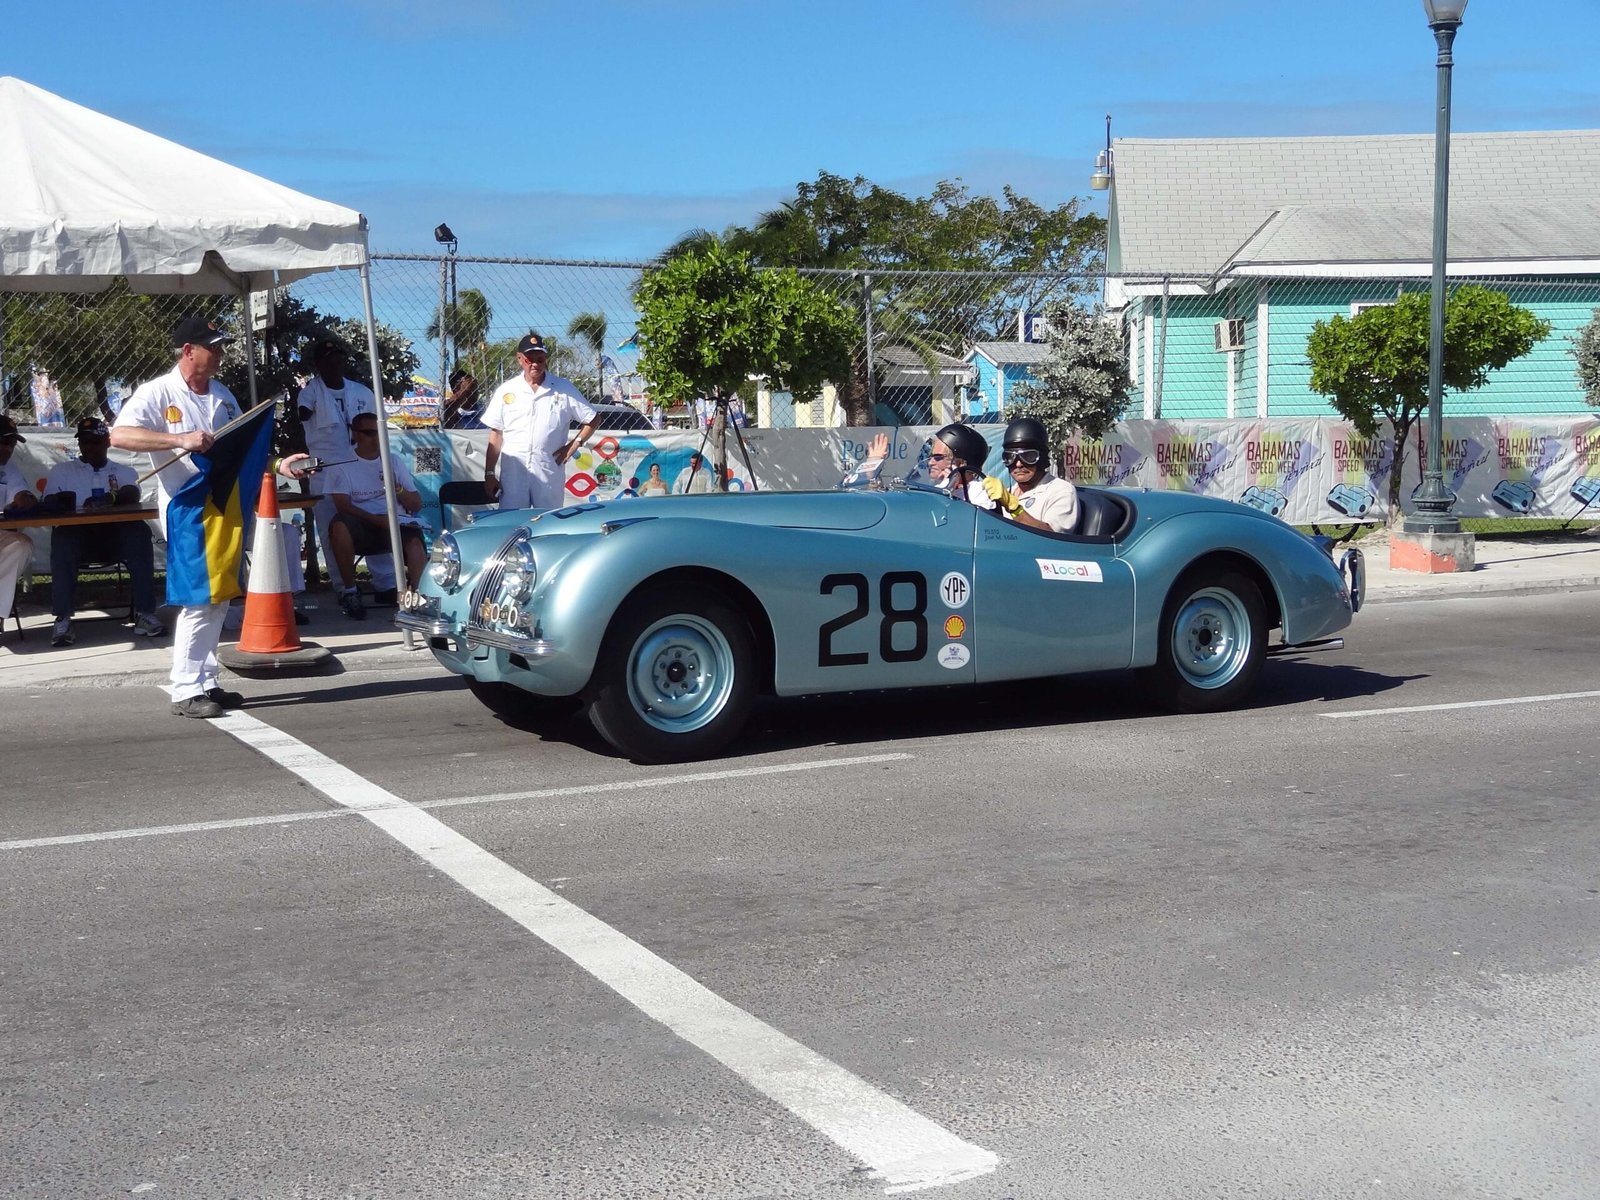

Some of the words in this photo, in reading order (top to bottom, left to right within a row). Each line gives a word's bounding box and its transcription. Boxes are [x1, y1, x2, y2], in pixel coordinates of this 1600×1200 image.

[842, 431, 908, 461] Pele
[1065, 444, 1122, 466] BAHAMAS
[1156, 442, 1213, 464] BAHAMAS
[1246, 440, 1301, 461] BAHAMAS
[1334, 439, 1386, 459] BAHAMAS
[1419, 439, 1468, 459] BAMAS
[1498, 437, 1546, 457] BAHAMAS
[1160, 463, 1184, 477] SPEED
[1187, 462, 1207, 476] WEEK
[1250, 461, 1274, 474] SPEED
[1277, 460, 1296, 474] WEEK
[1337, 459, 1360, 472] SPEED
[1363, 459, 1381, 472] WEEK
[1445, 459, 1464, 472] WEEK
[1501, 456, 1522, 470] SPEED
[1524, 455, 1542, 468] WEEK
[1578, 453, 1599, 466] SPEED
[1069, 466, 1094, 480] SPEED
[1097, 465, 1117, 479] WEEK
[1051, 563, 1089, 576] Local
[944, 577, 966, 604] YPF
[818, 570, 928, 667] 28
